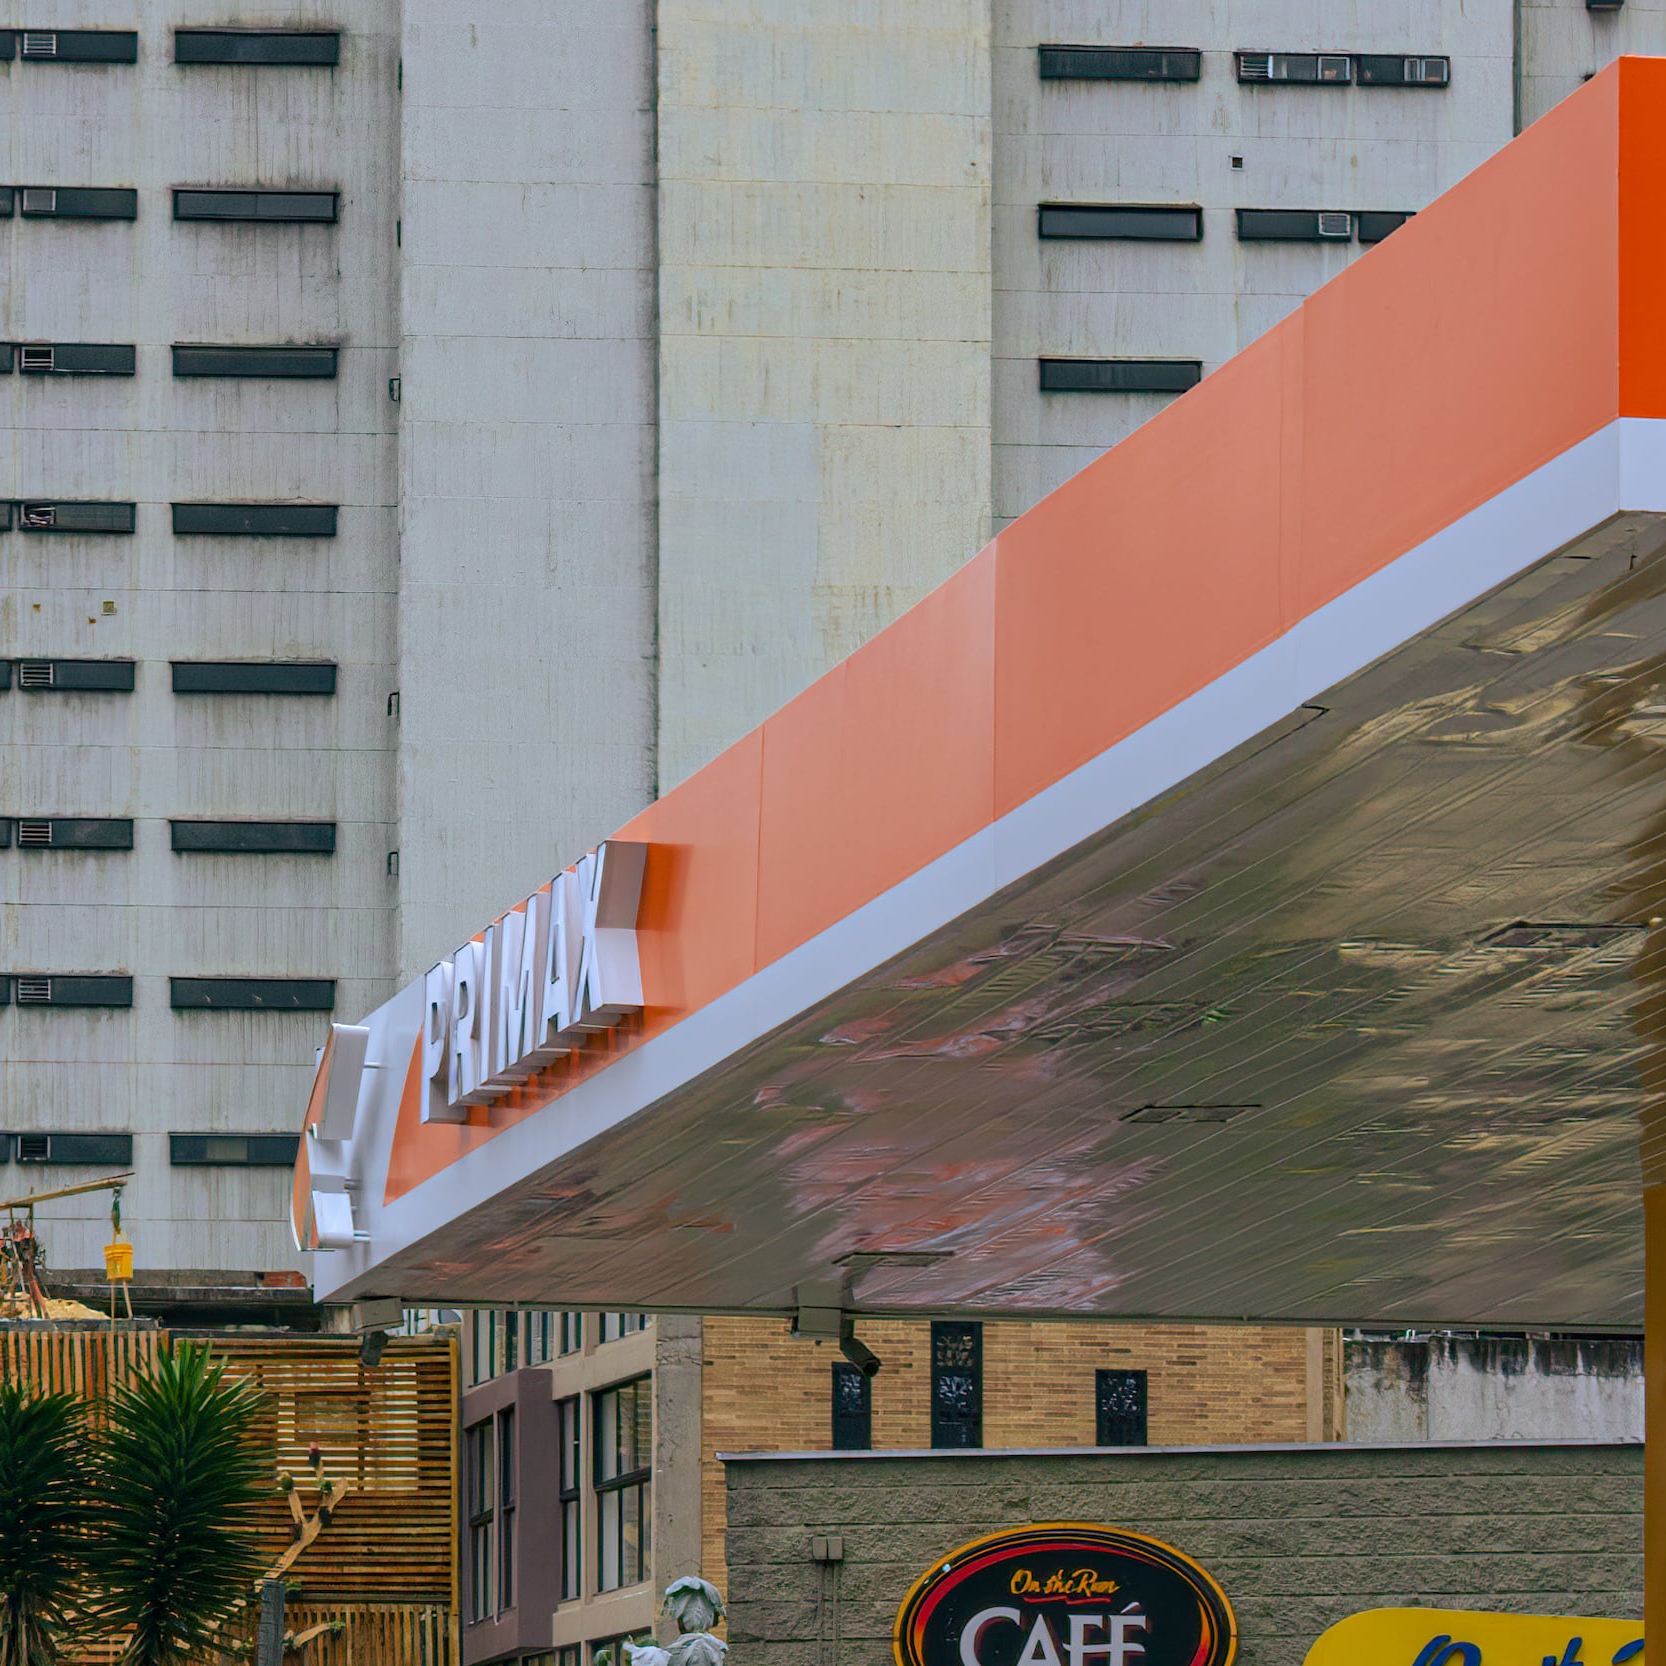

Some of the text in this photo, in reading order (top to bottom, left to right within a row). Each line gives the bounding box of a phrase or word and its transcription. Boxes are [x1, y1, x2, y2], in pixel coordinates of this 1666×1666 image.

[420, 840, 648, 1125] PRIMAX
[1010, 1568, 1121, 1597] On the Run
